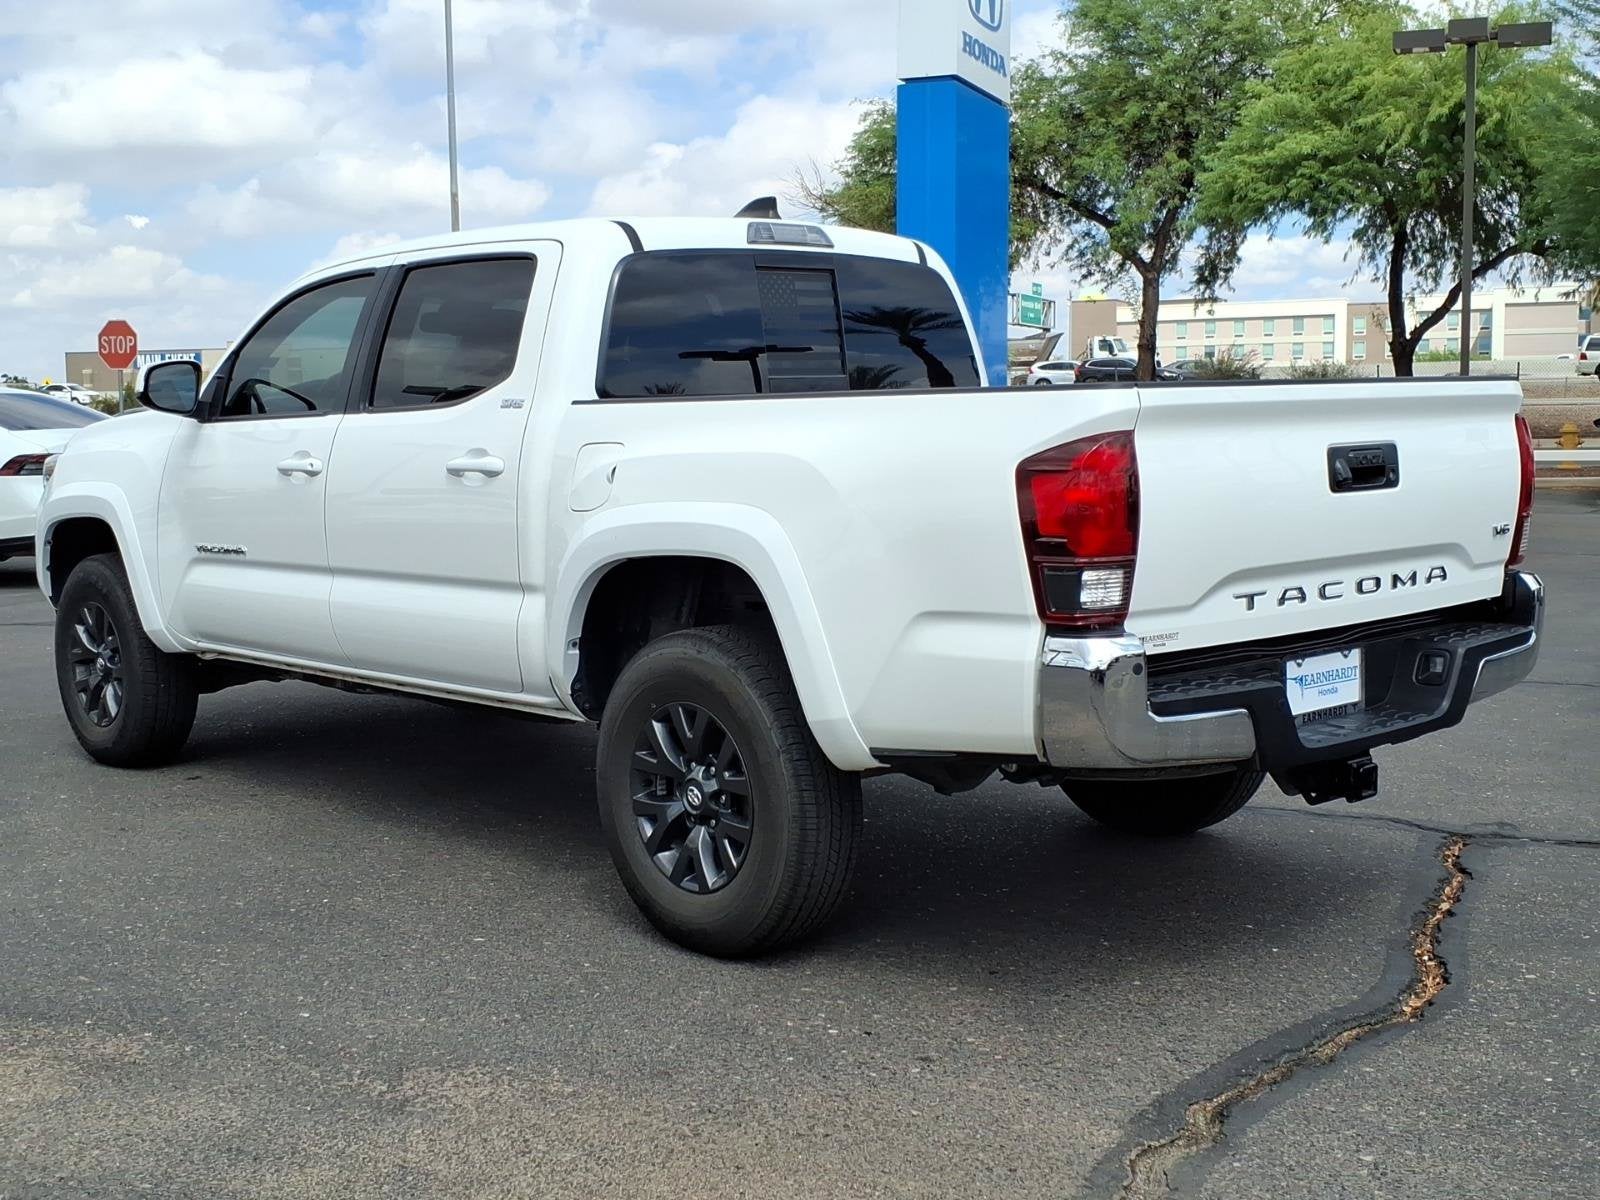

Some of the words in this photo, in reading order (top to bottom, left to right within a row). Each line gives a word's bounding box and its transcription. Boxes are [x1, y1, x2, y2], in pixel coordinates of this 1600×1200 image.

[961, 31, 1008, 78] HONDA
[100, 335, 135, 355] STOP
[1492, 523, 1510, 537] V6
[1232, 565, 1449, 612] TACOMA
[1144, 632, 1179, 643] EARNHARDT
[1303, 665, 1358, 687] EARNHARDT
[1317, 686, 1339, 697] Honda
[1302, 704, 1348, 724] EARNHARDT
